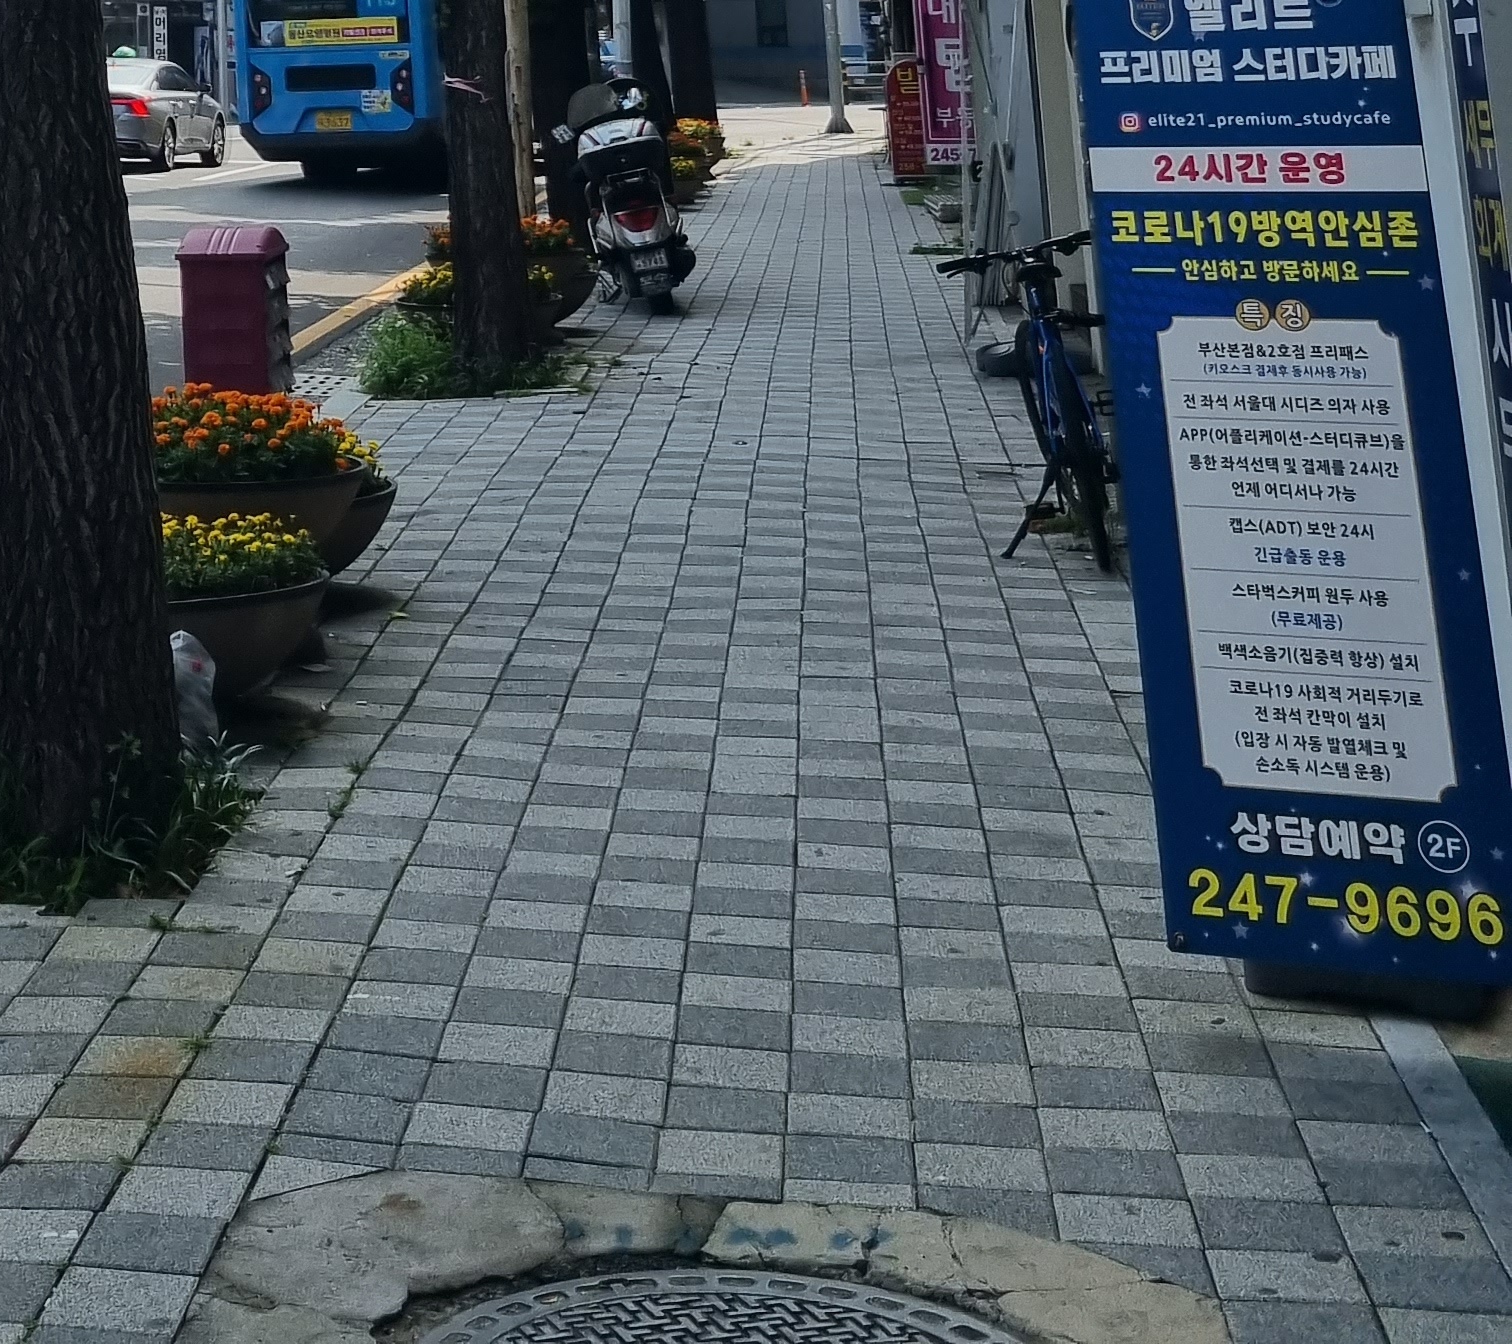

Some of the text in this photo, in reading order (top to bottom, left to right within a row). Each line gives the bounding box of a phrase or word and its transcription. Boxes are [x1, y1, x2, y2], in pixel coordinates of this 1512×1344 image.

[1099, 44, 1397, 84] 프리미엄 스터디카페
[1148, 110, 1391, 130] elite21_premium_studycafe
[1153, 151, 1346, 184] 24시간 운영
[1111, 209, 1420, 249] 코로나19방역안심존
[1181, 258, 1360, 283] 안심하고 방문하세요
[1198, 342, 1369, 361] 부산본점&2호점 프리패스
[1203, 364, 1251, 376] (키오스크
[1340, 366, 1366, 381] 가능)
[1183, 394, 1390, 415] 전 좌석 서울대 시디즈 의자 사용
[1189, 454, 1399, 479] 통한 좌석선택 및 결제를 24시간
[1231, 482, 1356, 503] 언제 어디서나 가능
[1229, 517, 1374, 540] 캡스(ADT) 보안 24시
[1254, 548, 1346, 567] 긴급출동 운용
[1232, 583, 1388, 607] 스타벅스커피 원두 사용
[1271, 610, 1343, 632] (무료제공)
[1218, 642, 1420, 672] 백색소음기(집중력 항상) 설치
[1229, 679, 1423, 707] 코로나19 사회적 거리두기로
[1255, 706, 1386, 731] 전 좌석 칸막이 설치
[1234, 730, 1407, 759] (입장 시 자동 발열체크 및
[1256, 756, 1391, 783] 손소독 시스템 운용)
[1230, 812, 1462, 864] 상담예약 2F
[1188, 868, 1505, 945] 247-9696
